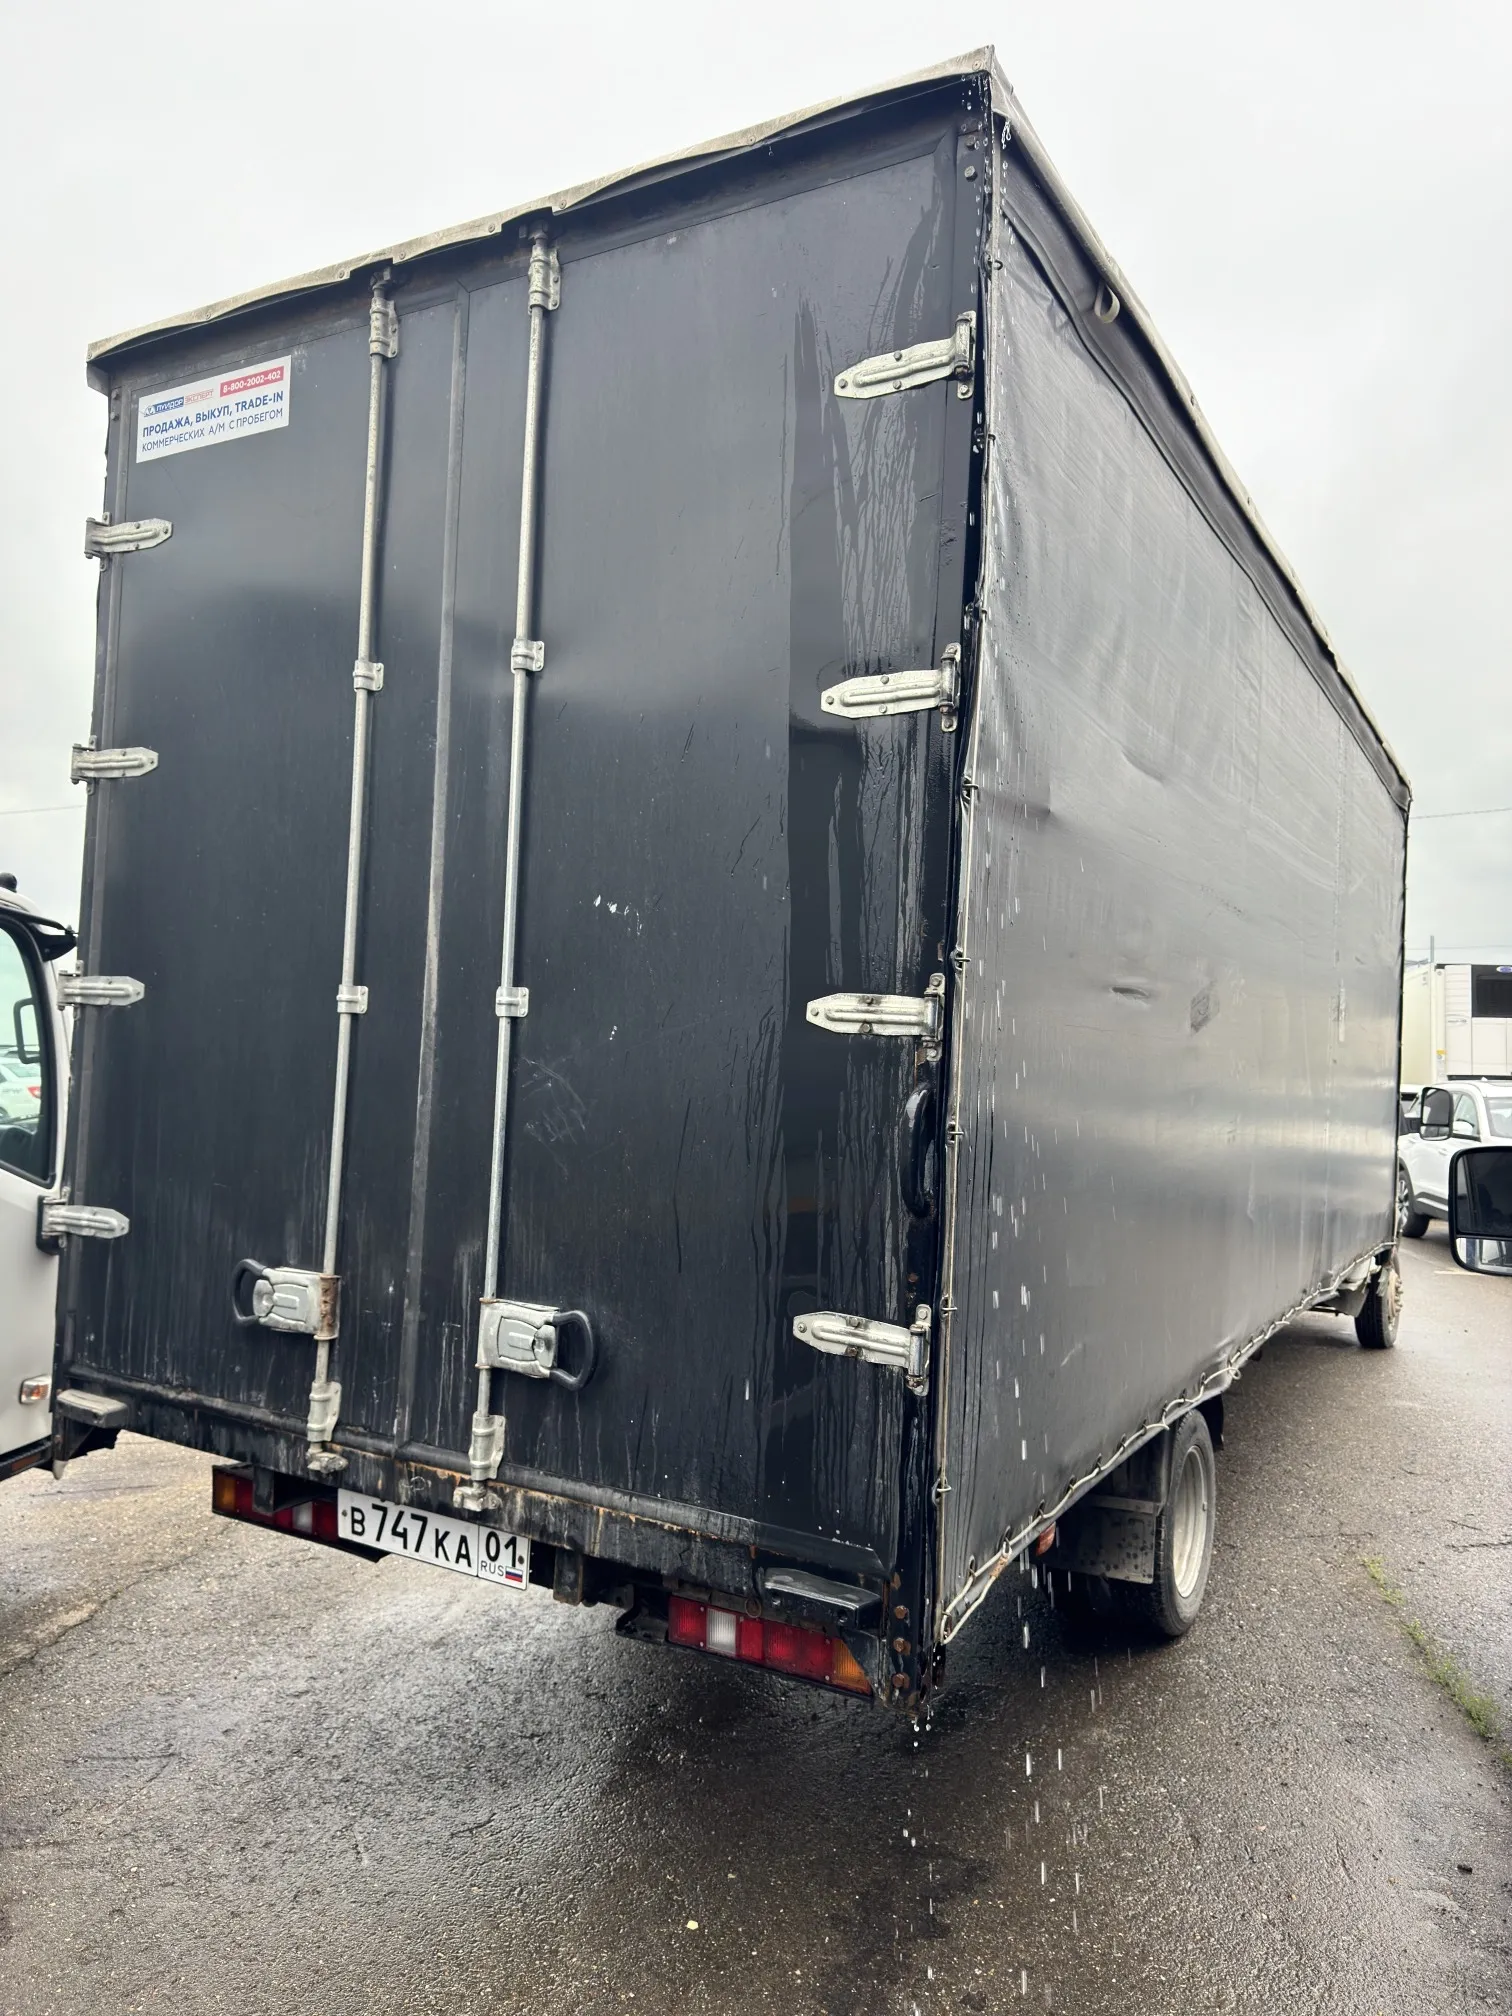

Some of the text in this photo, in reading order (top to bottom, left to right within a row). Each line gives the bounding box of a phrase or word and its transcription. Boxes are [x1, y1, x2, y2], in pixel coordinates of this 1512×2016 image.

[185, 390, 213, 403] ЭКСПЕРТ
[222, 370, 281, 393] 8-800-2002-402
[142, 391, 284, 438] ПРОДАЖА, ВЫКУП, TRADE-IN
[141, 408, 283, 453] КОММЕРЧЕСКИХ А/М С ПРОБЕГОМ
[485, 1530, 518, 1567] 01
[480, 1560, 504, 1577] RUS
